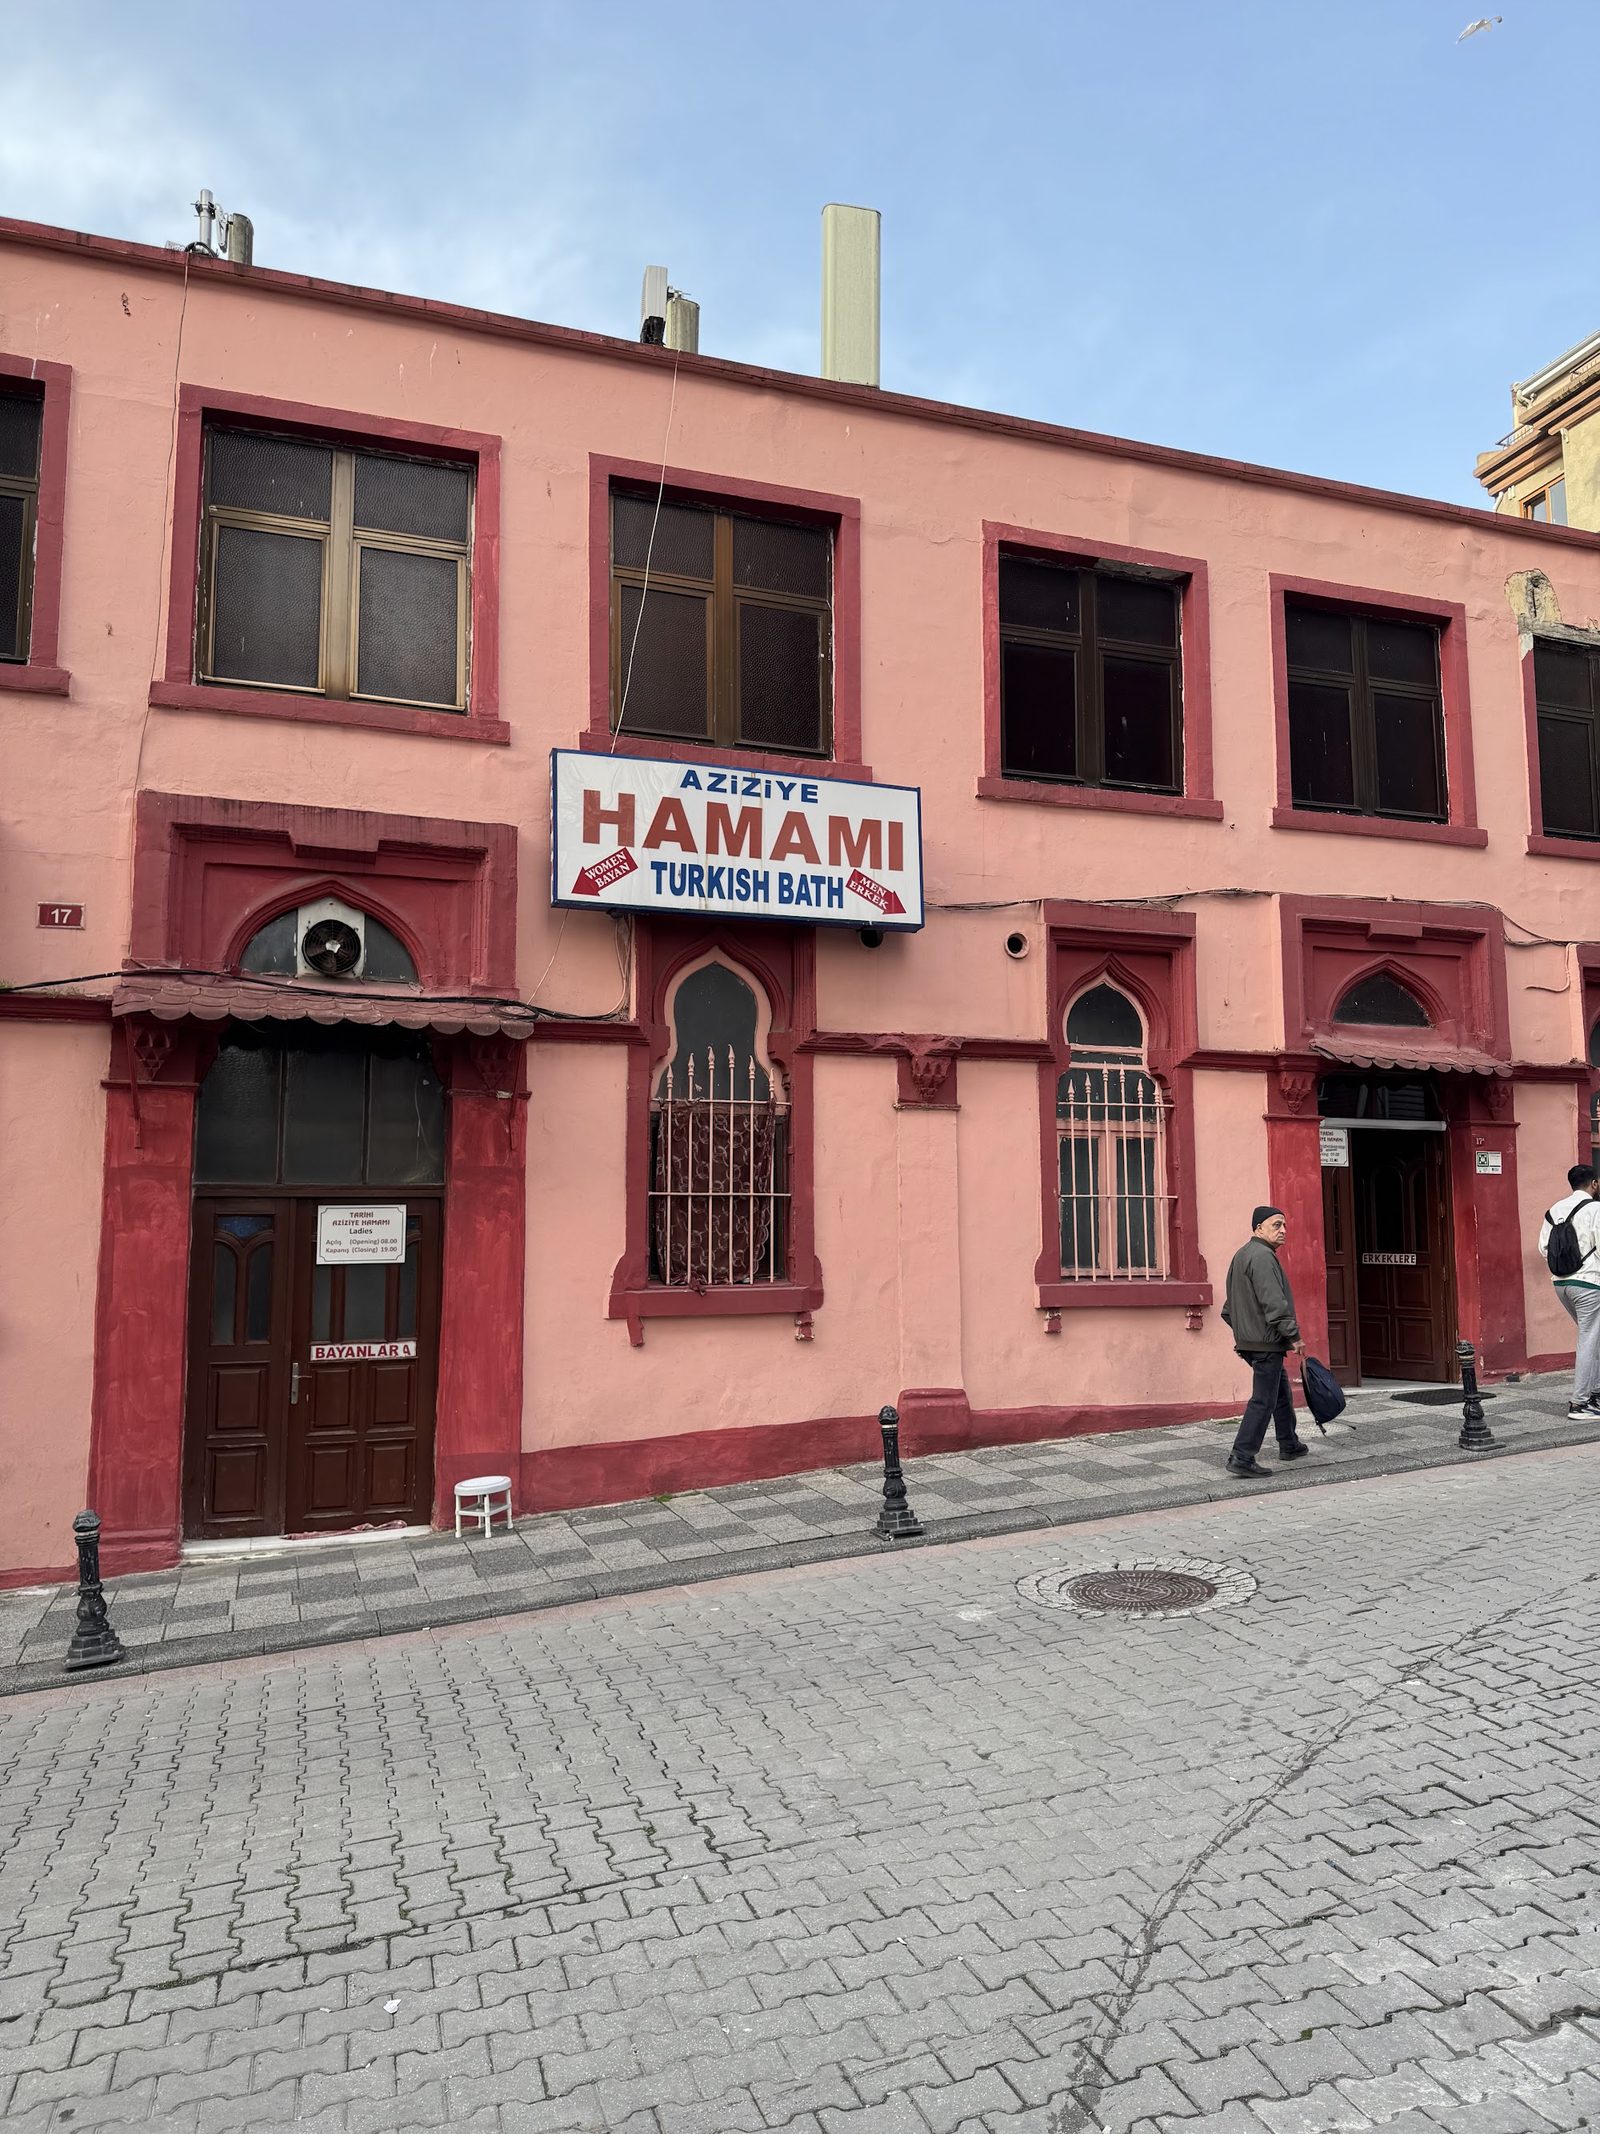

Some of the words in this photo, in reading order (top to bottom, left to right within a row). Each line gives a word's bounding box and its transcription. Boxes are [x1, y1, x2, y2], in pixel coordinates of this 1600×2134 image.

[582, 789, 904, 872] HAMAMI
[585, 851, 627, 880] WOMEN
[595, 862, 630, 888] BAYAN
[650, 860, 770, 904] TURKISH
[778, 871, 844, 909] BATH
[849, 880, 889, 910] ERKEK
[860, 876, 887, 897] MEN
[51, 908, 72, 924] 17
[361, 1219, 391, 1227] HAMAMI
[349, 1238, 380, 1246] (Opening)
[351, 1246, 379, 1254] (Closing)
[1363, 1254, 1416, 1264] ERKEKLERE
